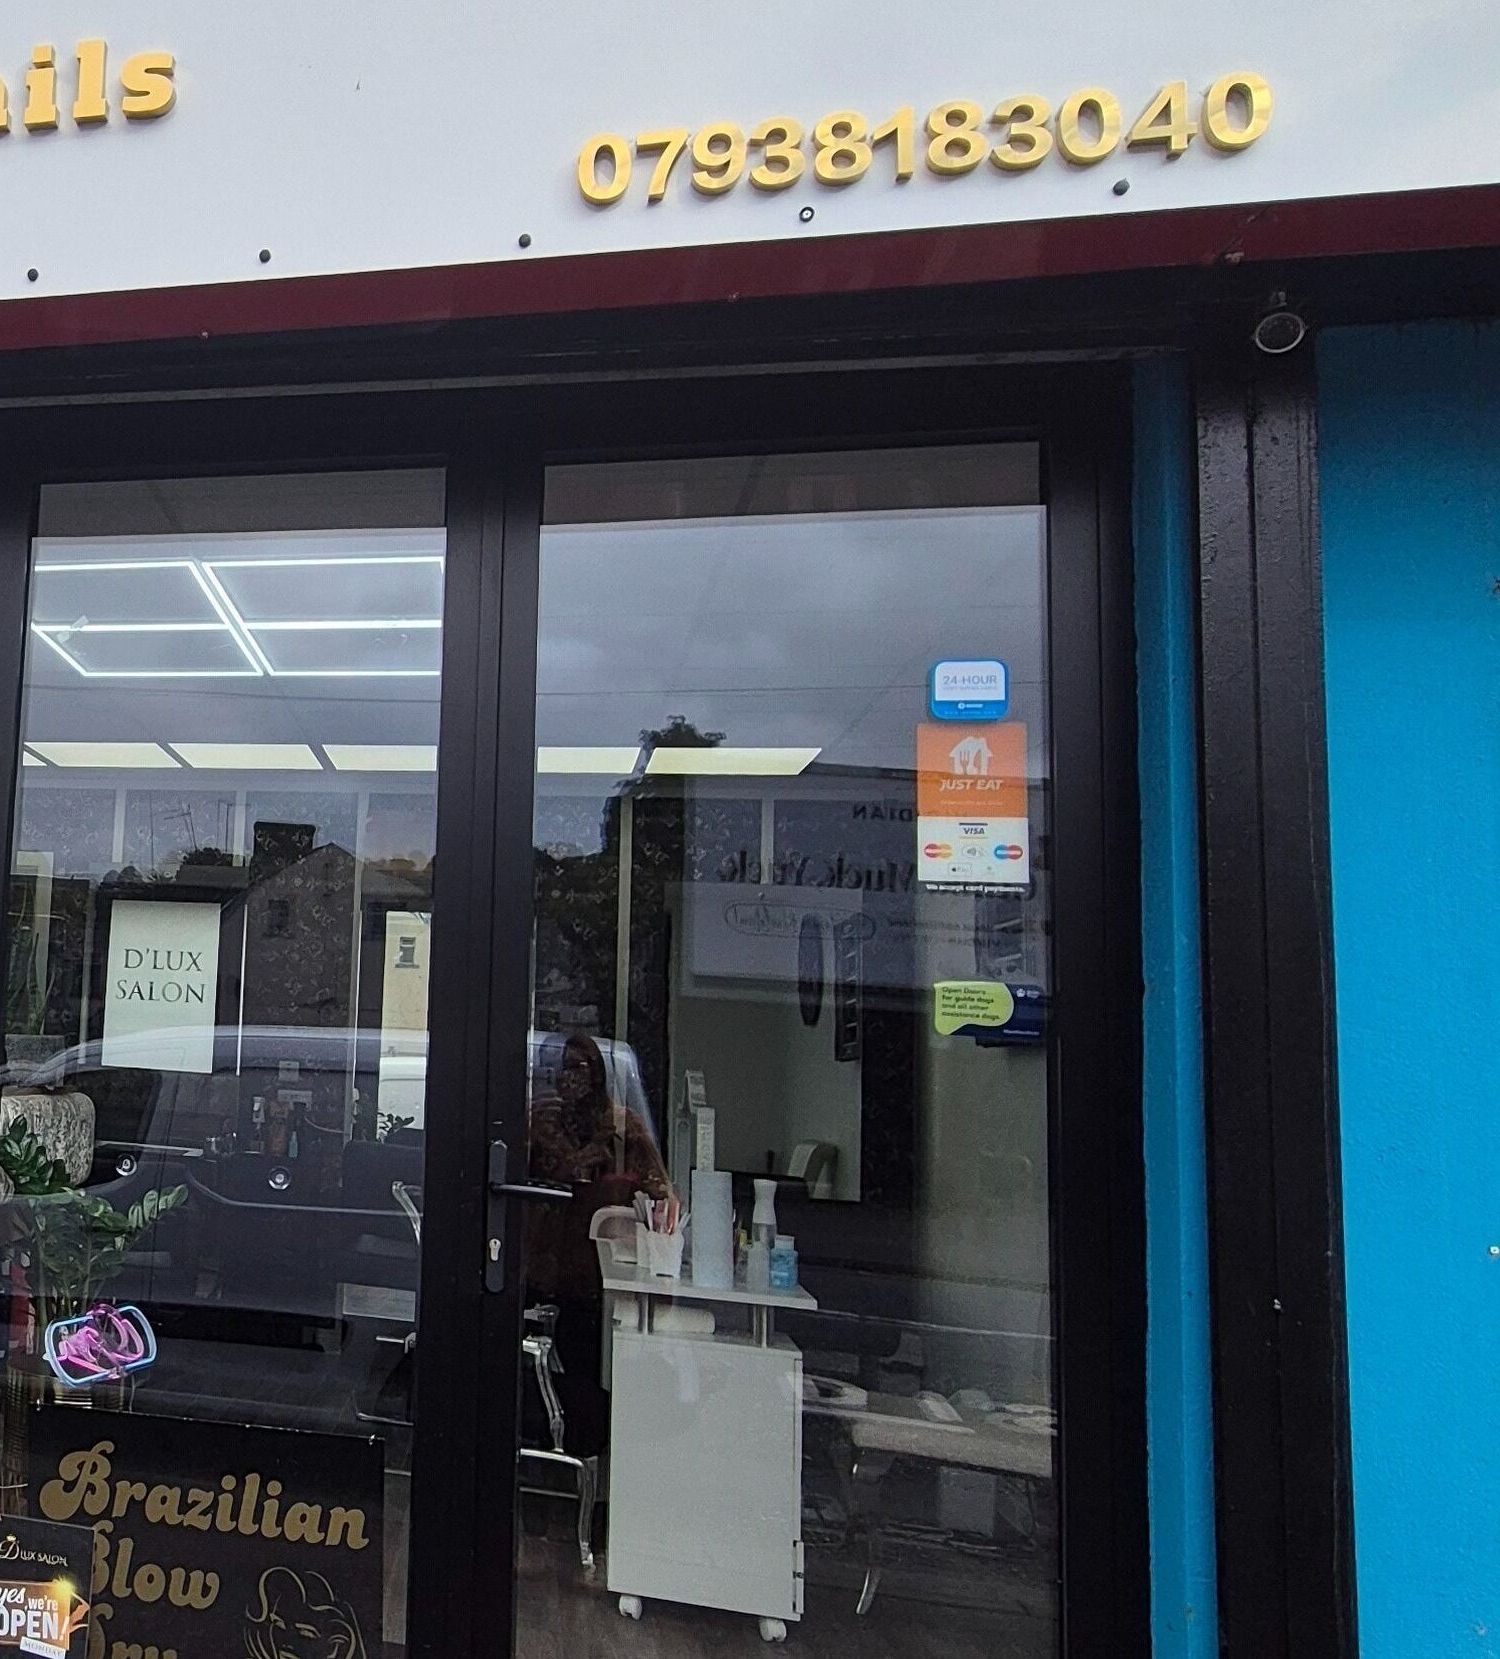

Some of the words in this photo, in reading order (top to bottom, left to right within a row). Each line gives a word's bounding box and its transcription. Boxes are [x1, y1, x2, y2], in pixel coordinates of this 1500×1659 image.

[576, 70, 1275, 207] 07938183040
[939, 779, 974, 791] JUST
[975, 779, 1004, 791] EAT
[963, 827, 986, 836] VISA
[123, 948, 204, 972] D'LUX
[115, 979, 206, 1004] SALON
[39, 1440, 370, 1550] Brazilian
[28, 1594, 59, 1612] we're
